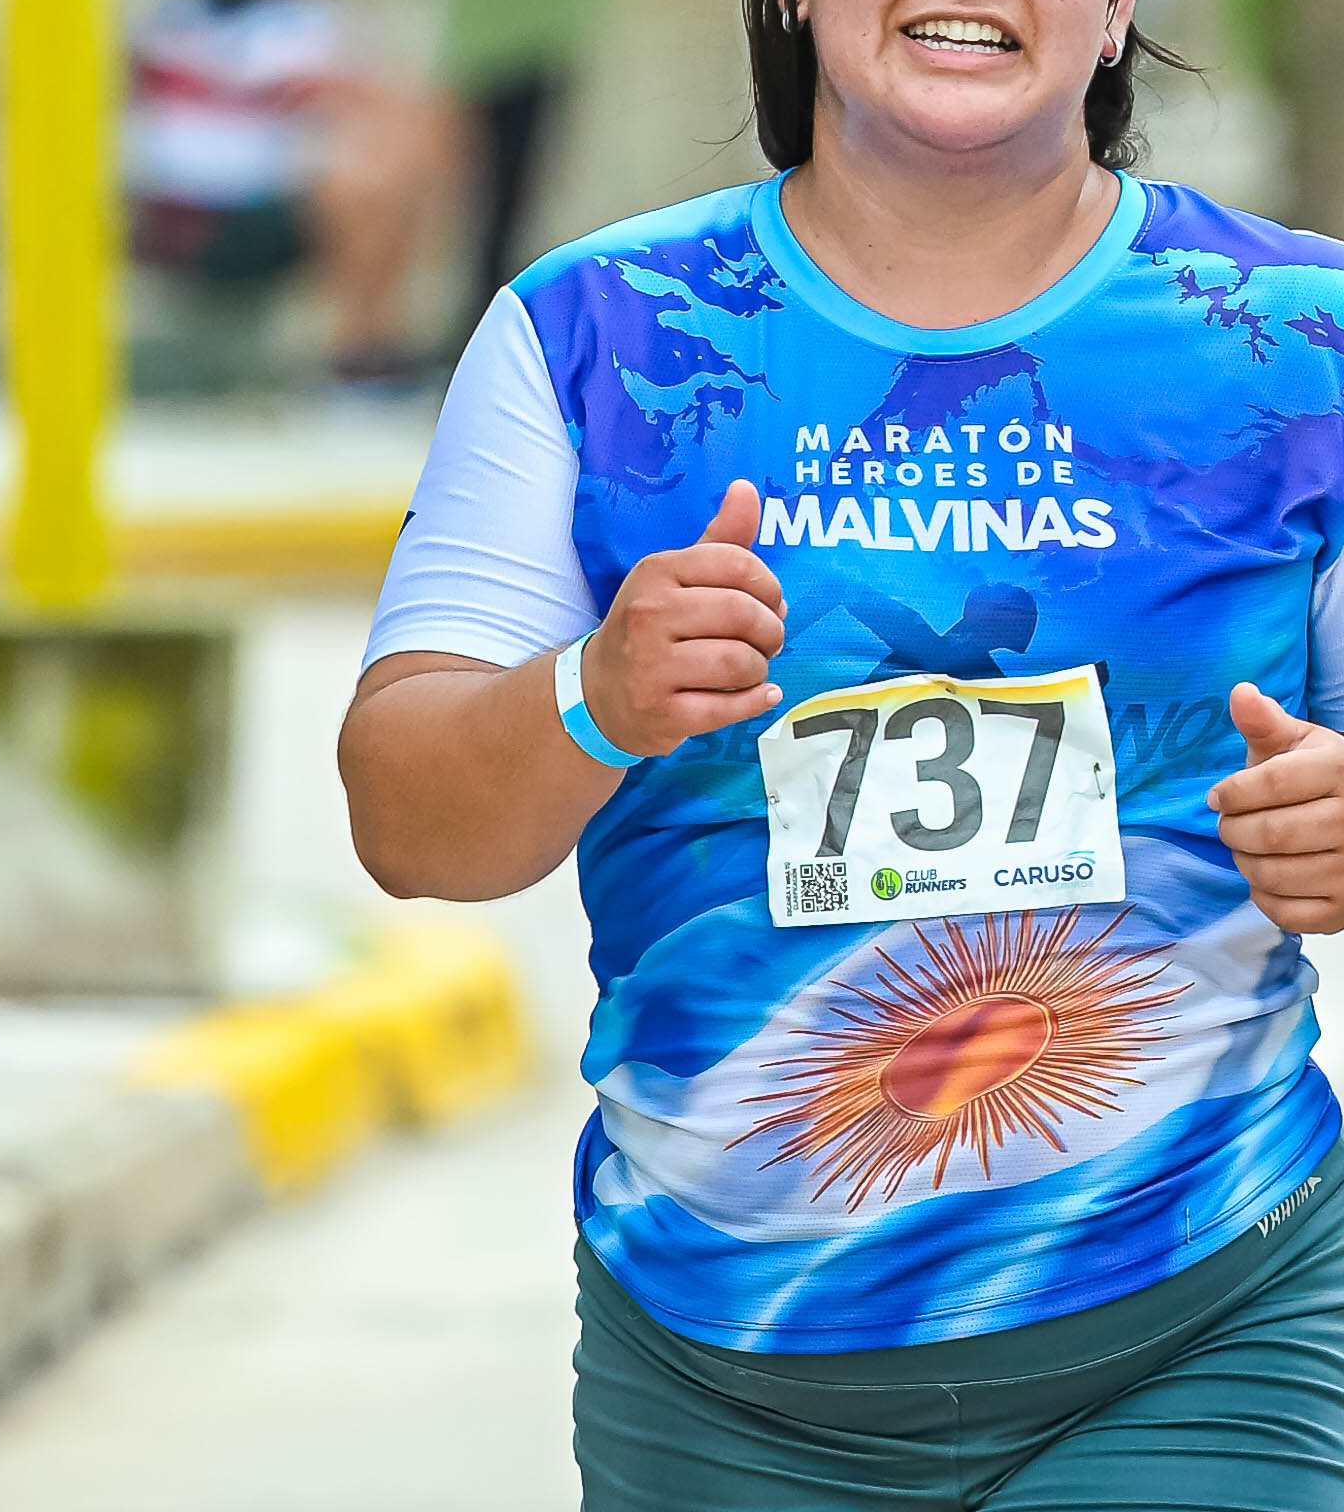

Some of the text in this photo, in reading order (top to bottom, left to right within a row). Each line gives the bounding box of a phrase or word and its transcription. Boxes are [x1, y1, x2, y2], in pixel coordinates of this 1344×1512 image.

[795, 418, 1073, 454] MARATÓN
[795, 458, 1074, 487] HÉROES DE
[758, 494, 1117, 552] MALVINAS
[793, 698, 1066, 858] 737
[905, 869, 937, 882] CLUB
[905, 878, 967, 894] RUNNER'S
[994, 862, 1094, 887] CARUSO
